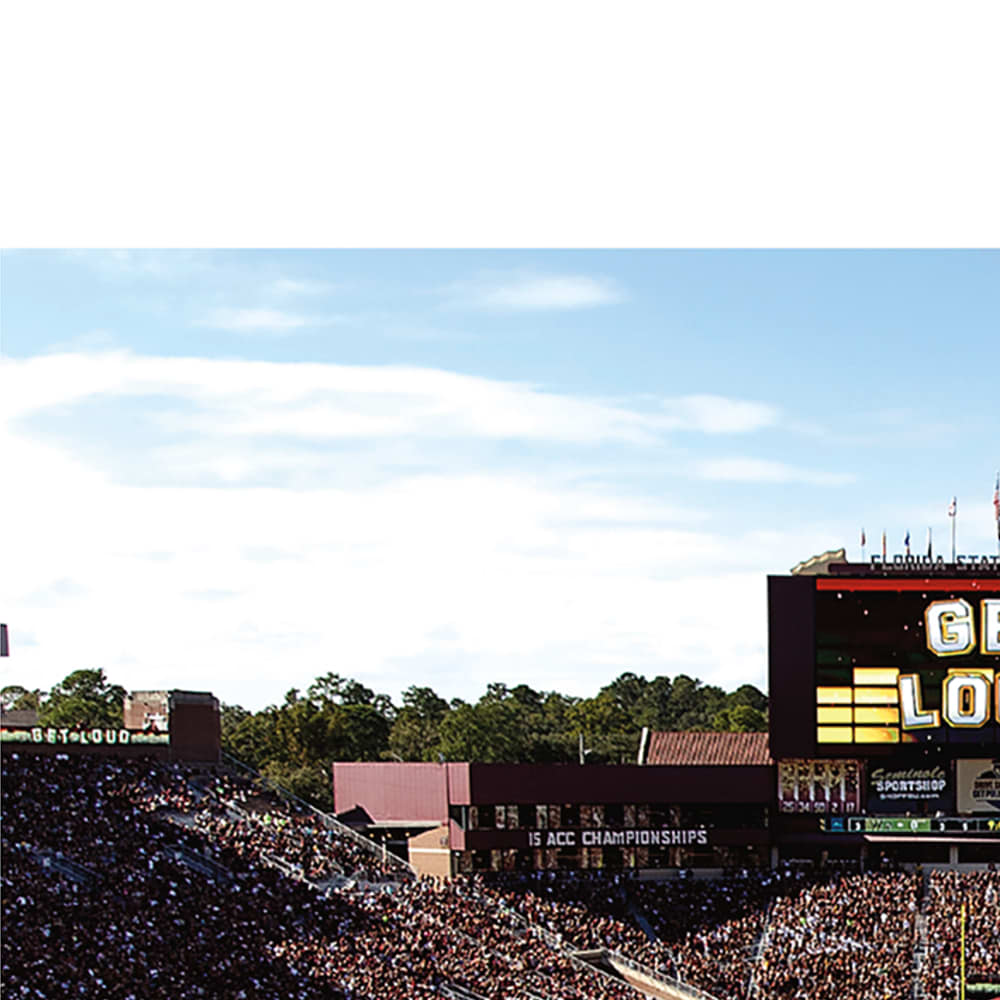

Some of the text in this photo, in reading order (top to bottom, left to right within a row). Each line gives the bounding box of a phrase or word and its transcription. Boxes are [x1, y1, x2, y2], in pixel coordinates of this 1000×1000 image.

[870, 555, 947, 571] FLORIDA
[31, 728, 130, 744] GET LOUD
[876, 780, 946, 792] SPORTSHOP
[528, 830, 708, 846] 15 ACC CHAMPIONSHIPS
